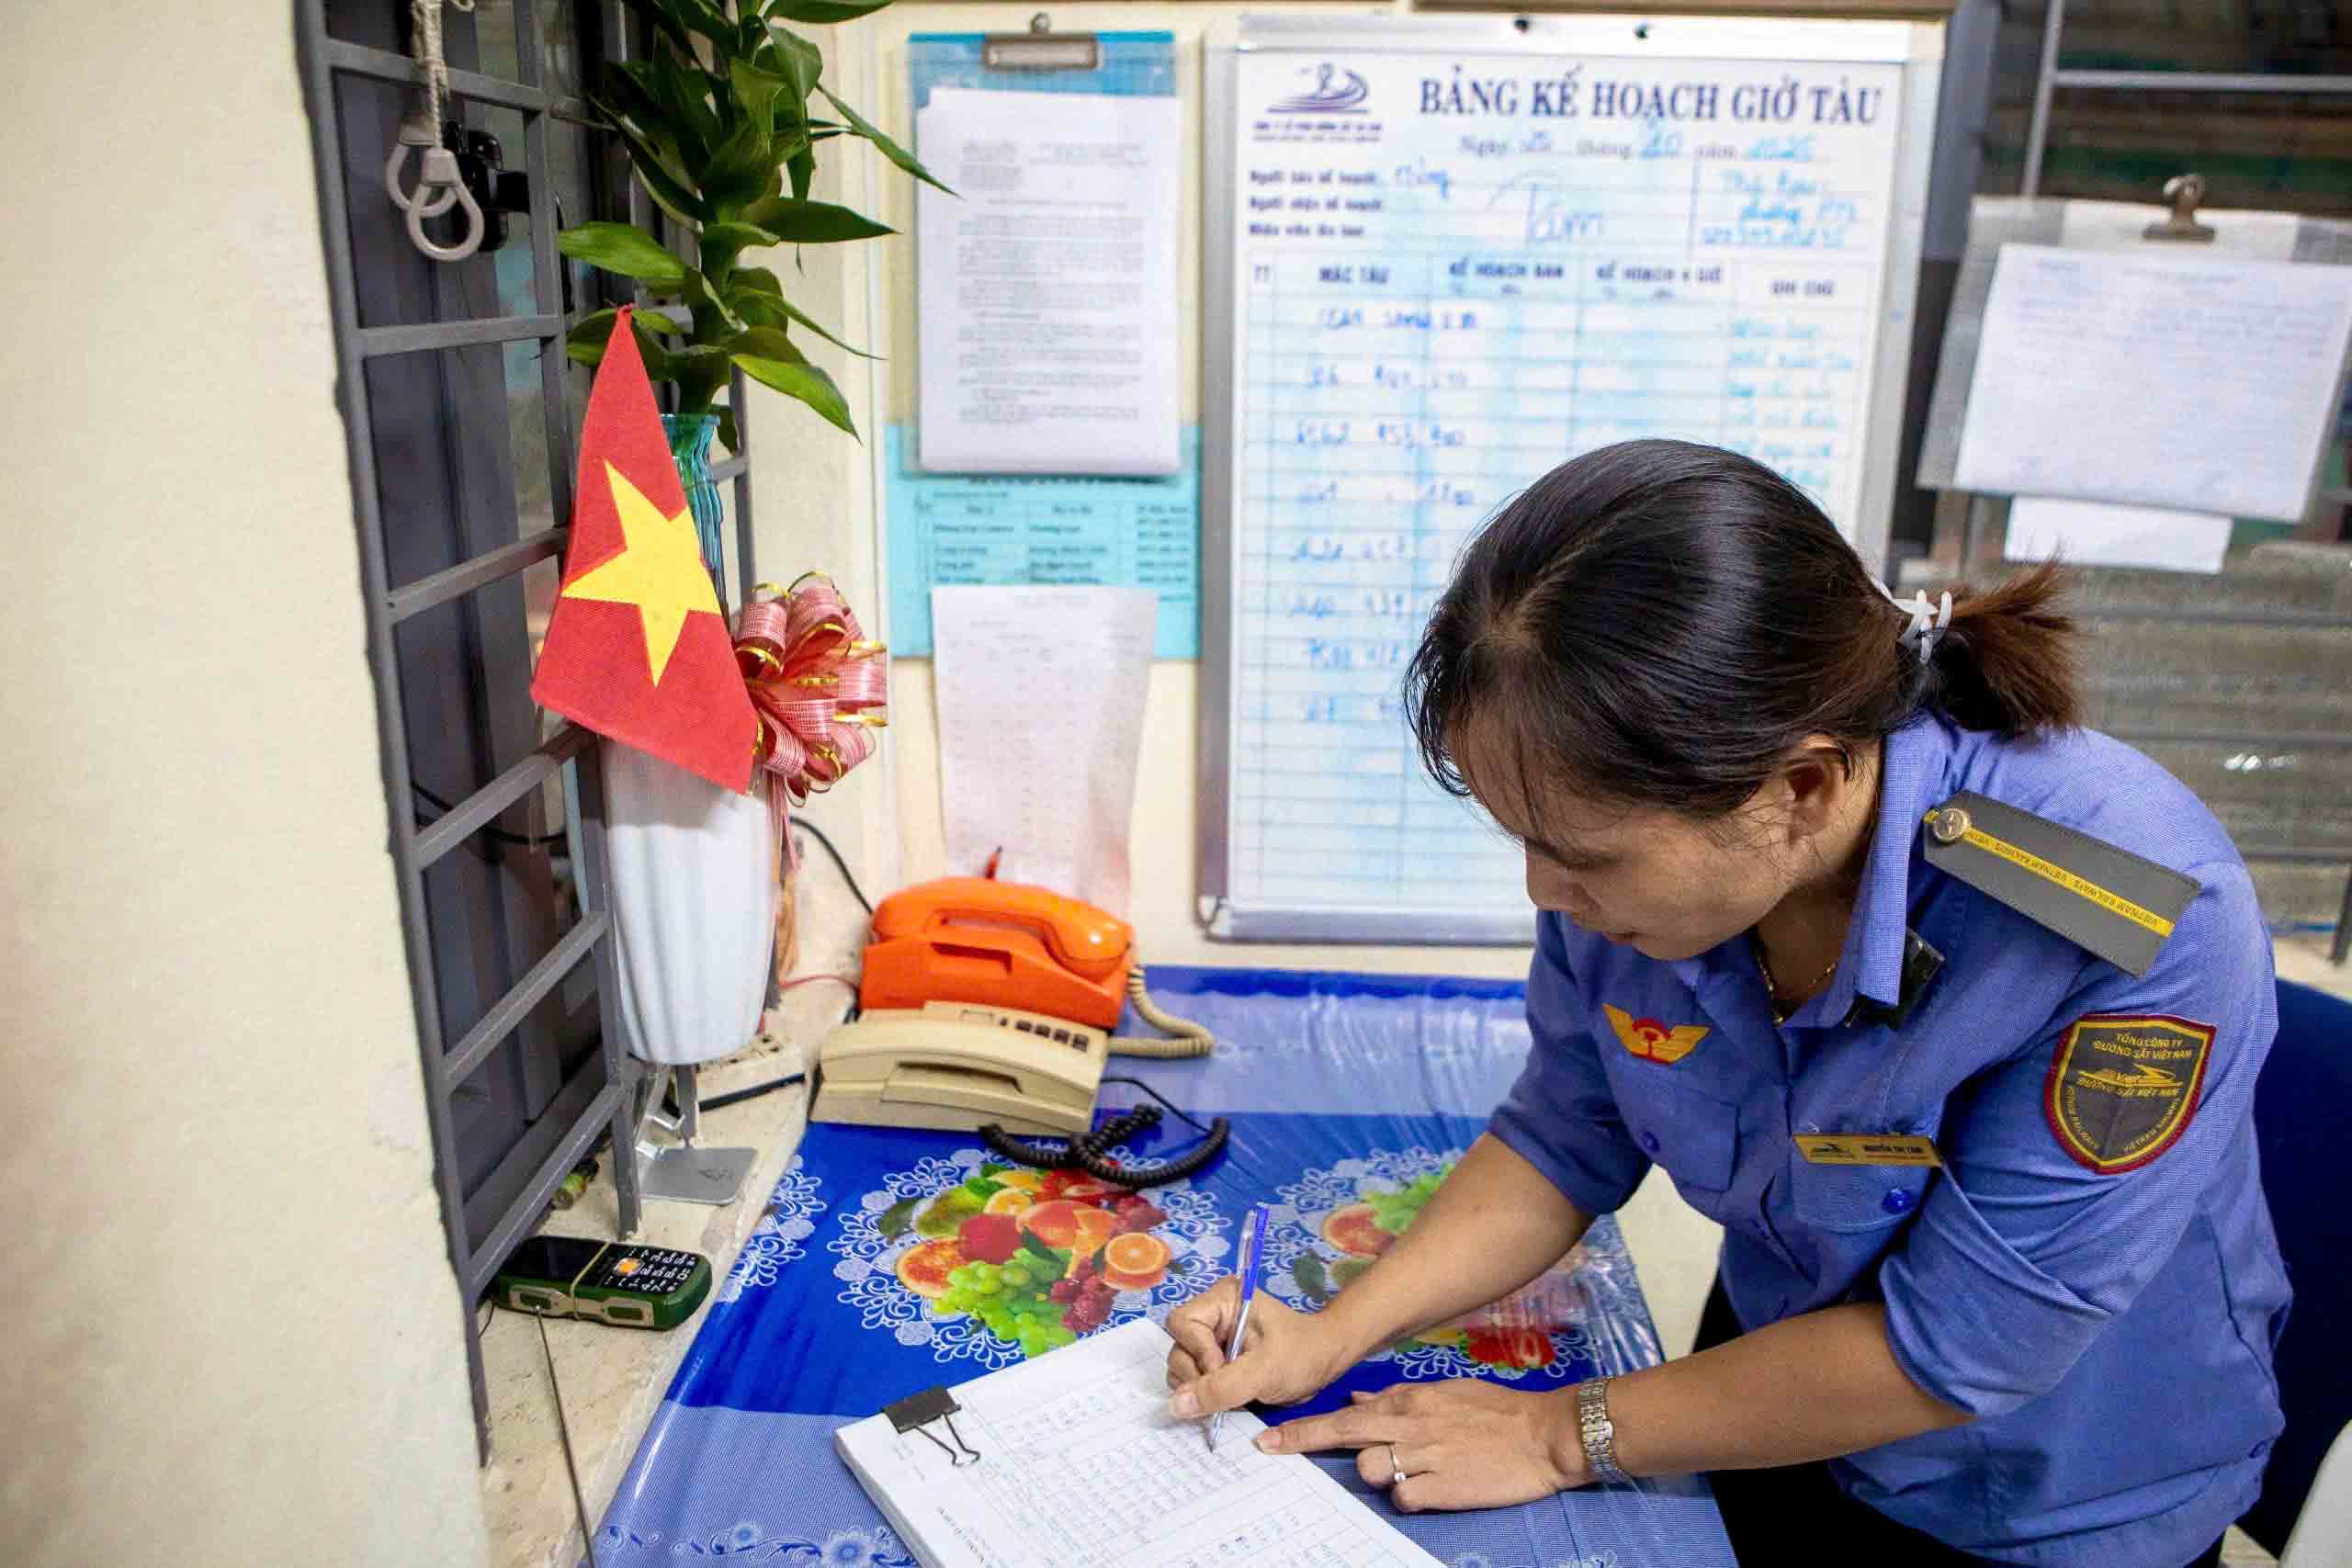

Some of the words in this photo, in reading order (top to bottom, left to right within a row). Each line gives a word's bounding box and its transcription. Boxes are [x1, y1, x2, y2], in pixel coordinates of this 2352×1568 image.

[1419, 63, 1518, 116] BẢNG
[1531, 62, 1585, 117] KẾ
[1591, 81, 1720, 125] HOẠCH
[1731, 75, 1802, 122] GIỜ
[1808, 77, 1883, 123] TÀU
[2116, 1031, 2142, 1046] TỔNG
[2144, 1035, 2169, 1048] CÔNG
[2173, 1050, 2191, 1058] NAM
